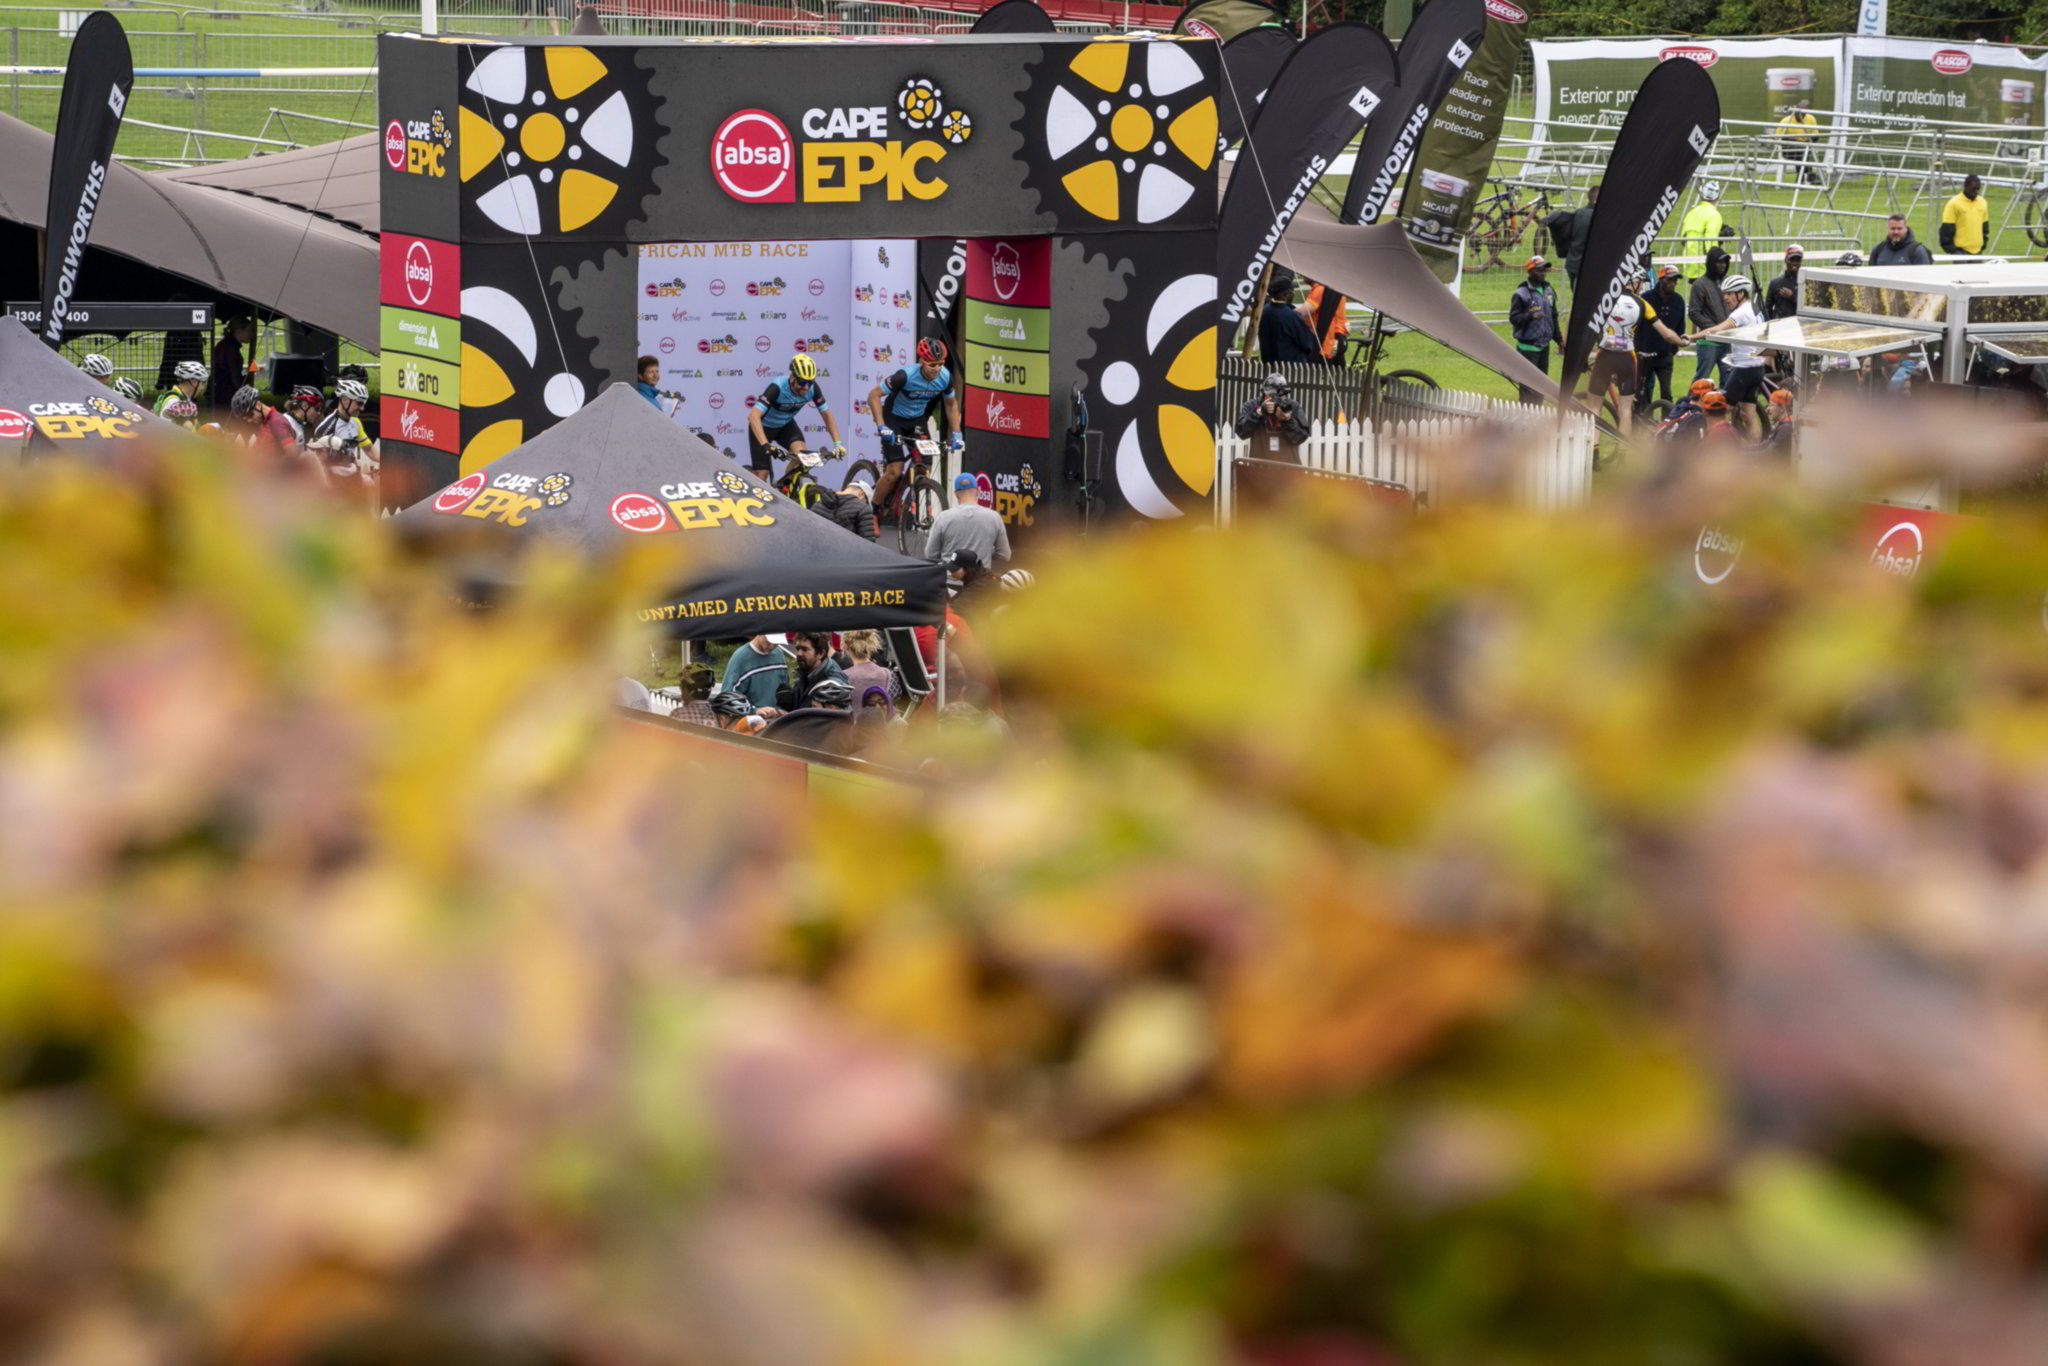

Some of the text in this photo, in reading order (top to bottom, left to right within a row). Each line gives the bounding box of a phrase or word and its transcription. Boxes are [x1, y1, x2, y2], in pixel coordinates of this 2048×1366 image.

[1935, 56, 1970, 66] PLASCON
[1463, 70, 1489, 88] Race
[1359, 94, 1372, 108] W
[1482, 95, 1493, 107] in
[1560, 86, 1638, 107] Exterior pro
[1857, 83, 1966, 108] Exterior protection that
[802, 107, 887, 138] CAPE
[1446, 104, 1485, 122] exterior
[407, 120, 430, 141] CAPE
[1433, 118, 1486, 141] protection.
[407, 139, 445, 178] EPIC
[724, 138, 781, 165] absa
[803, 140, 949, 202] EPIC
[47, 160, 105, 343] WOOLWORTHS
[638, 243, 808, 257] FRICAN MTB RACE
[1588, 184, 1678, 334] WOOLWORTHS
[409, 259, 430, 281] absa
[995, 257, 1017, 277] absa
[67, 311, 89, 322] 400
[984, 313, 1013, 328] dimension
[399, 319, 428, 335] dimension
[999, 327, 1013, 339] data
[414, 334, 428, 347] data
[398, 362, 439, 396] exxaro
[984, 355, 1026, 385] exxaro
[28, 402, 89, 416] CAPE
[35, 415, 139, 439] EPIC
[412, 423, 435, 441] active
[998, 414, 1021, 430] active
[446, 484, 475, 497] absa
[493, 473, 538, 493] CAPE
[660, 482, 720, 500] CAPE
[995, 473, 1019, 493] CAPE
[462, 487, 542, 527] EPIC
[619, 506, 659, 521] absa
[667, 497, 777, 530] EPIC
[995, 490, 1035, 527] EPIC
[637, 590, 905, 622] UNTAMED AFRICAN MTB RACE
